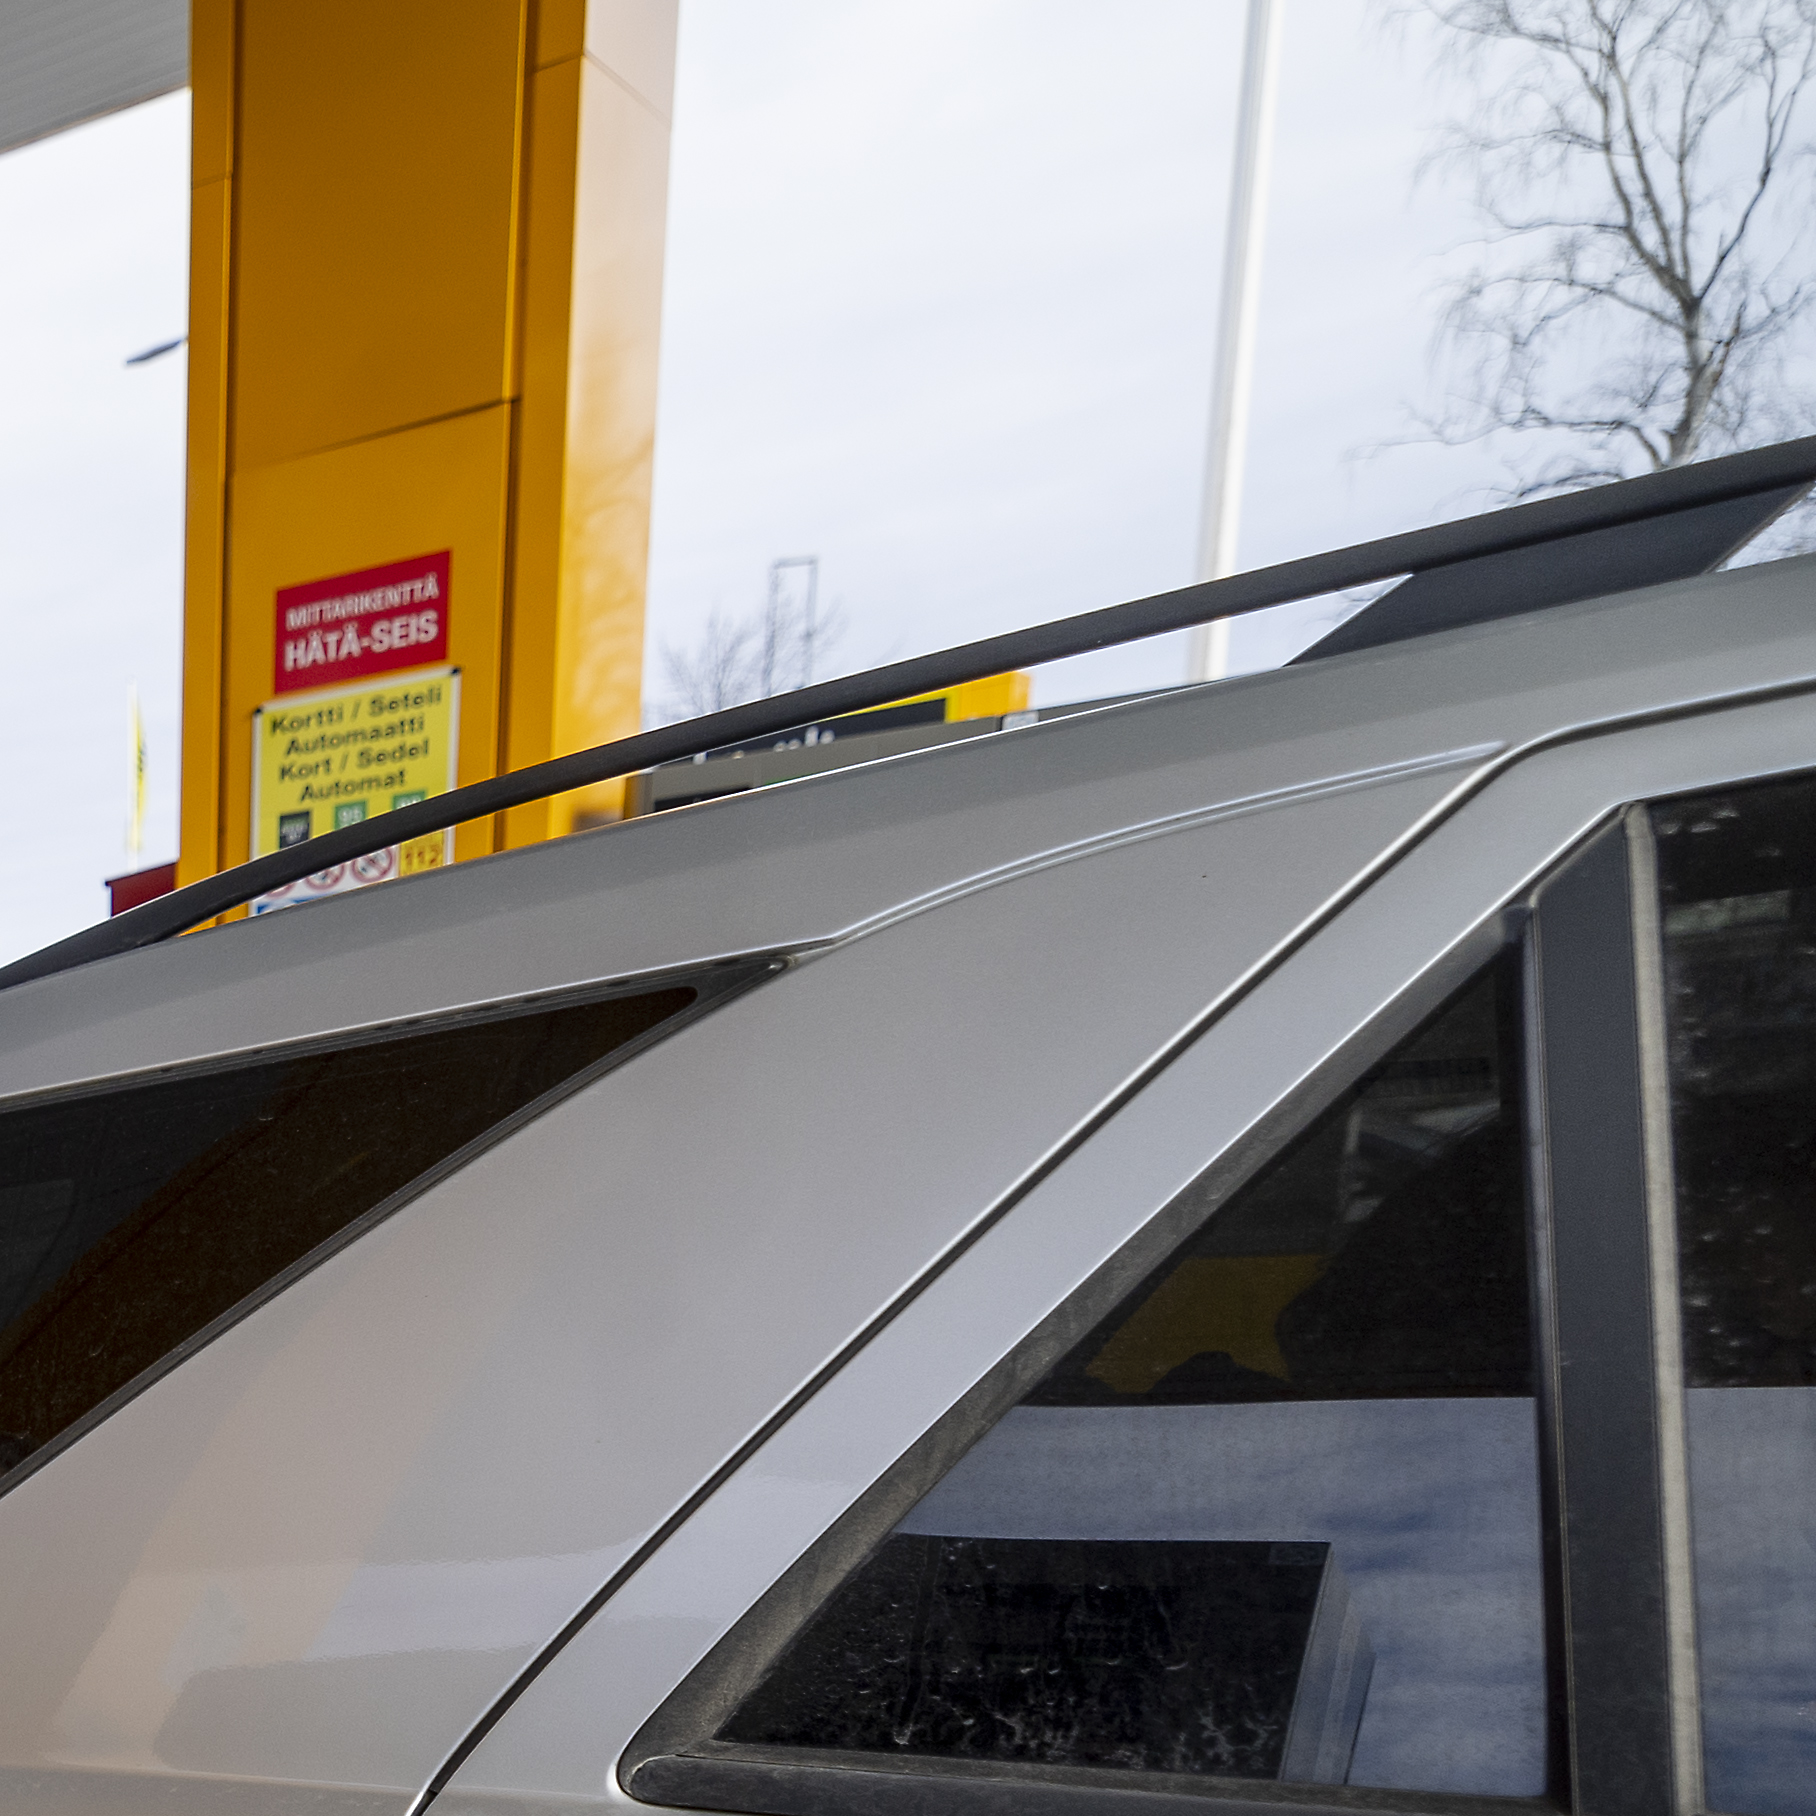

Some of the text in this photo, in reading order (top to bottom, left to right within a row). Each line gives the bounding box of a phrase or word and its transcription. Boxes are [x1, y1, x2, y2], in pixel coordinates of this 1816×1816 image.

[285, 571, 439, 631] MITTARIKENTTÄ
[284, 608, 439, 672] HÄTÄ-SEIS
[271, 704, 344, 735] Kortti
[369, 686, 442, 718] Seteli
[286, 714, 425, 756] Automaatti
[280, 758, 332, 782] Kort
[356, 739, 429, 769] Sedel
[301, 769, 406, 801] Automat
